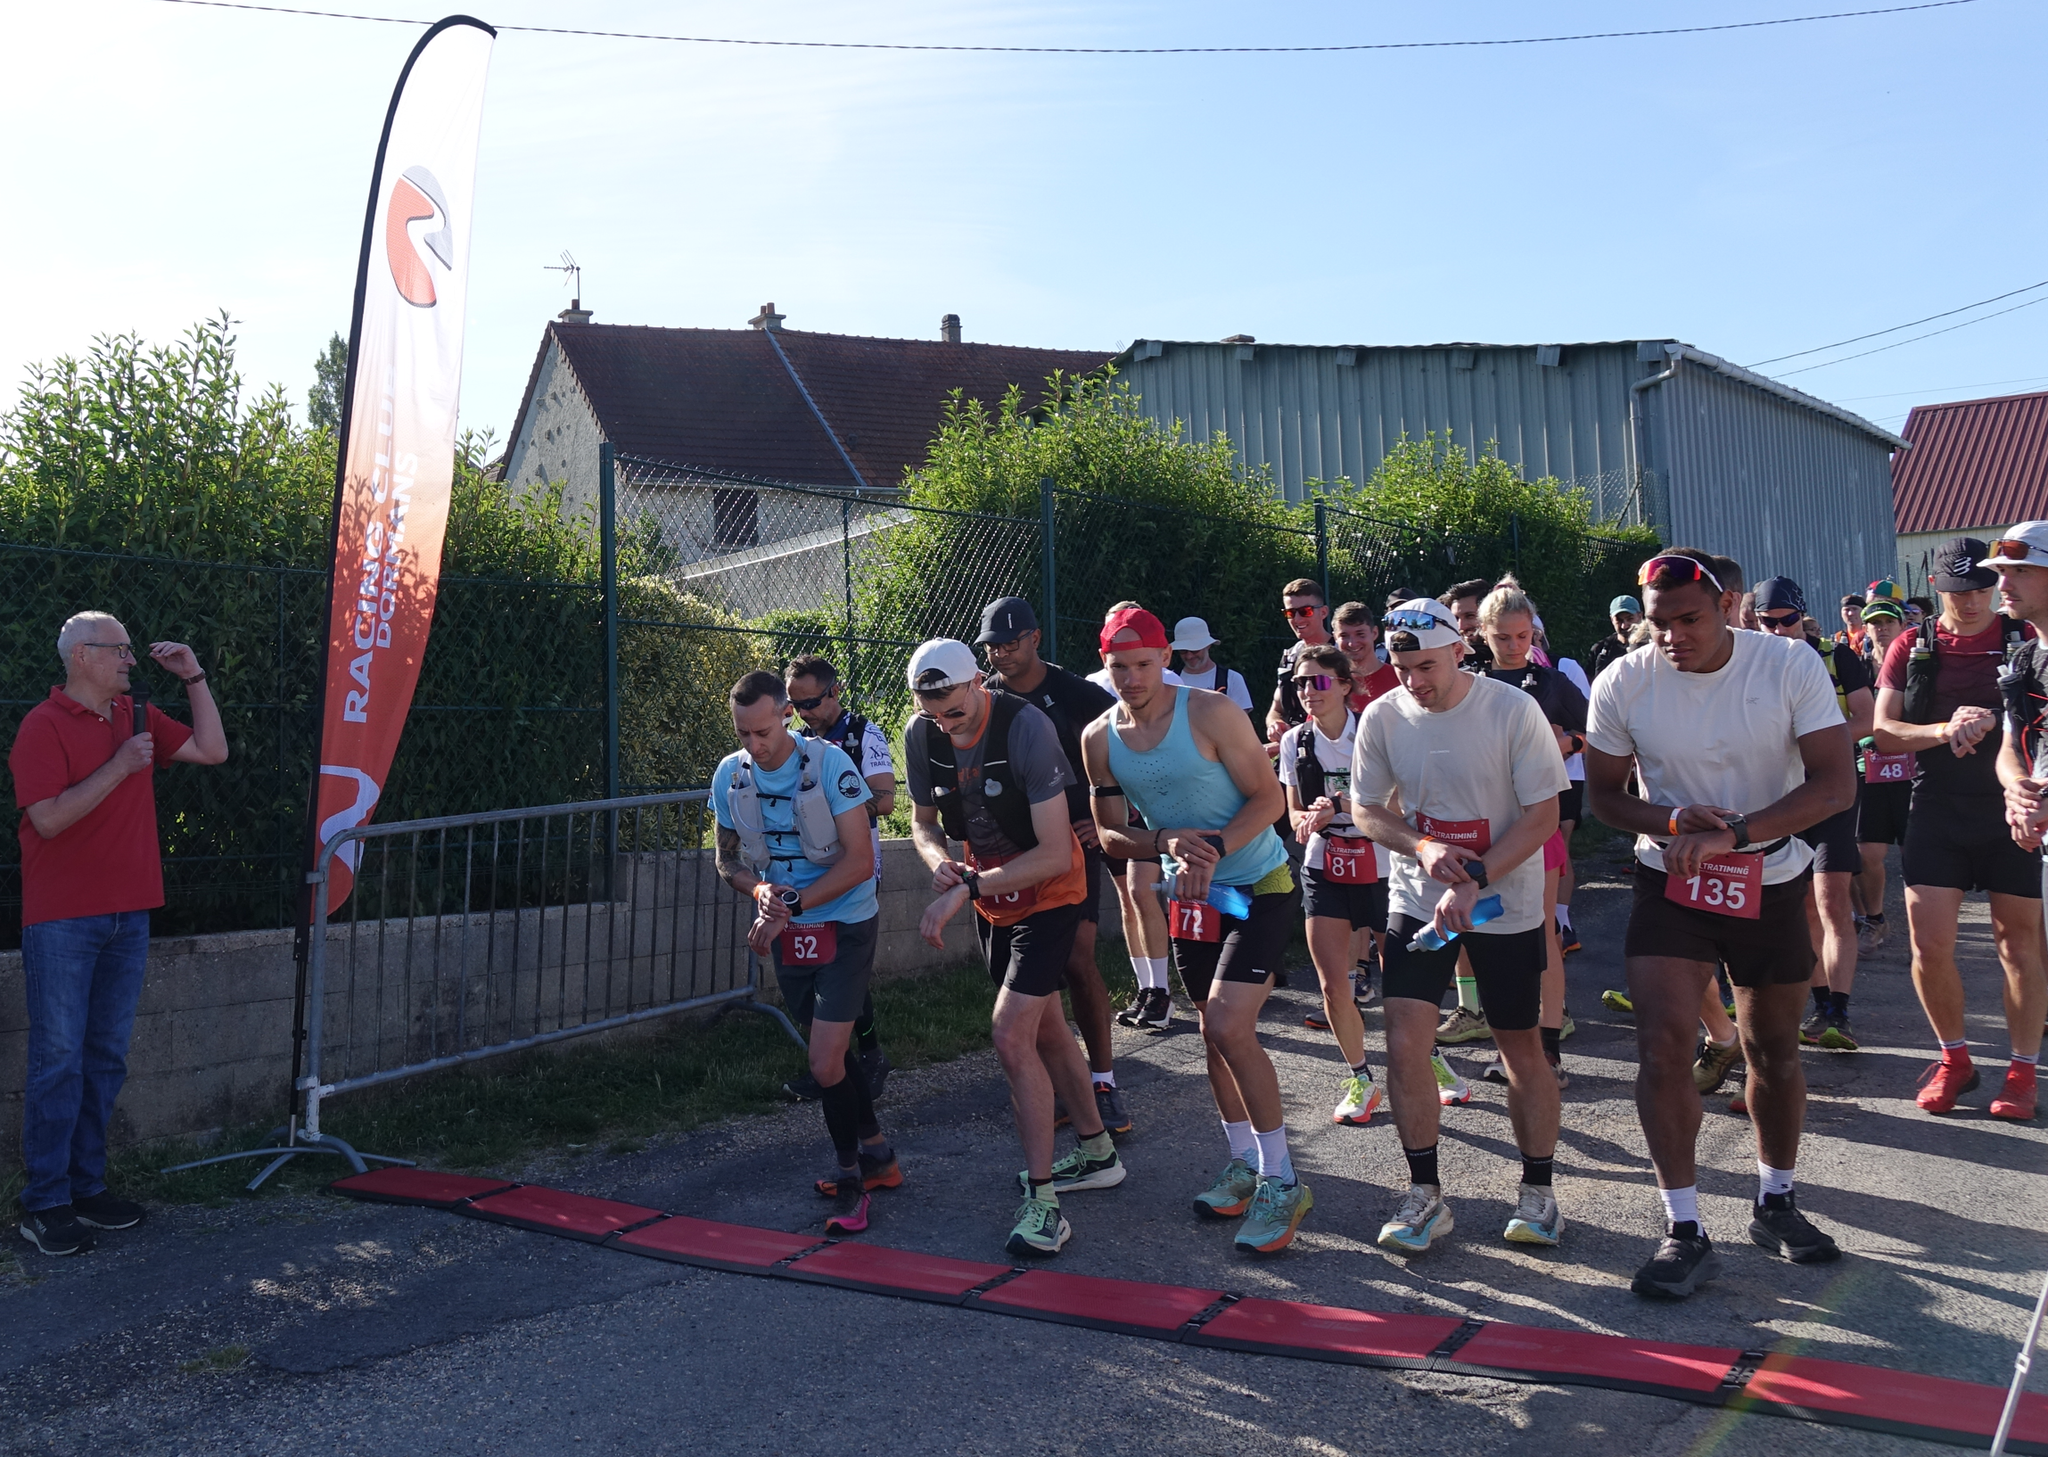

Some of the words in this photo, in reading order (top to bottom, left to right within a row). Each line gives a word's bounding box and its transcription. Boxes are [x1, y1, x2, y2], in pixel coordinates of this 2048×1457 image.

[343, 521, 384, 723] RACING
[372, 364, 396, 504] CLUB
[376, 452, 418, 648] DORMANS
[1880, 763, 1903, 779] 48
[1430, 830, 1478, 840] ULTRATIMING
[1330, 847, 1366, 855] ULTRATIMING
[1332, 857, 1357, 878] 81
[1699, 862, 1749, 875] LTRATIMING
[1686, 876, 1746, 910] 135
[1180, 908, 1204, 933] 72
[794, 935, 818, 960] 52
